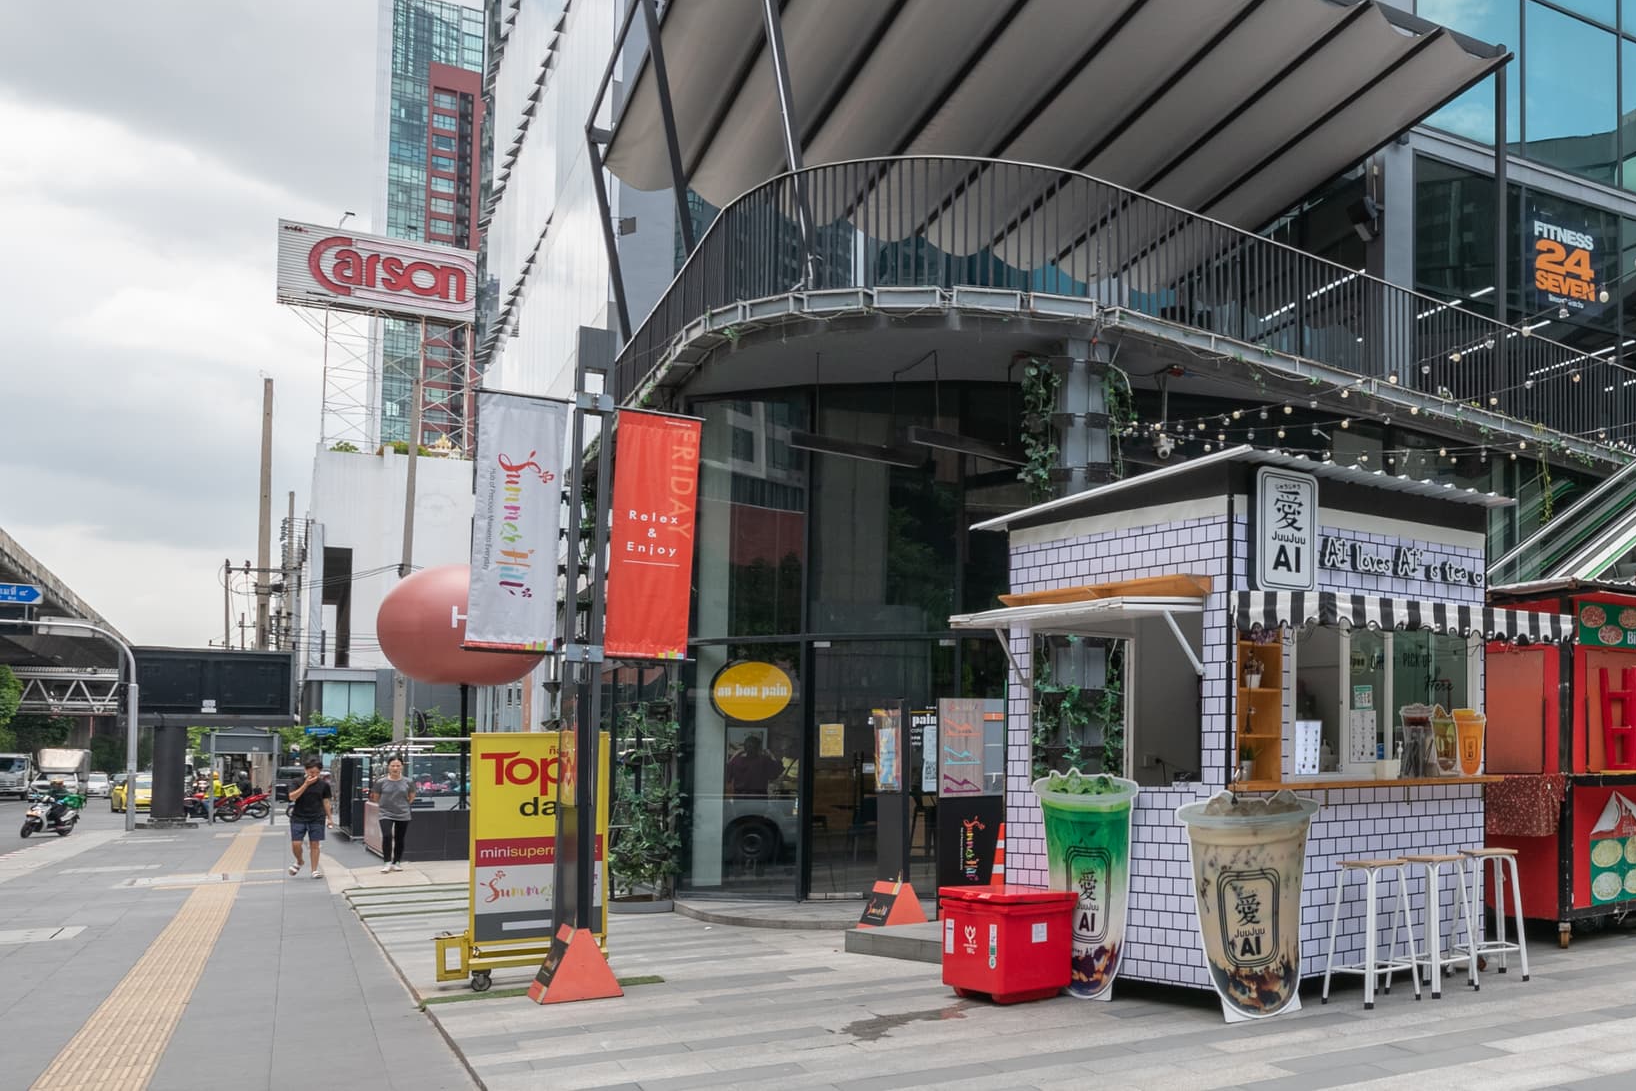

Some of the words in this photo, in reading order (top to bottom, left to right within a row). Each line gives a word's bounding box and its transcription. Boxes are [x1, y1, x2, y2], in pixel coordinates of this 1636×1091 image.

[1533, 220, 1594, 251] FITNESS
[308, 236, 467, 302] Carson
[1535, 239, 1595, 282] 24
[1535, 270, 1596, 302] SEVEN
[667, 428, 697, 540] FRIDAY
[1274, 490, 1304, 532] 愛
[648, 528, 657, 538] &
[1272, 531, 1306, 545] JuuJuu
[626, 541, 678, 558] Enjoy
[1272, 544, 1301, 573] AI
[1357, 541, 1391, 573] loves
[1448, 561, 1467, 582] tea
[717, 685, 732, 697] au
[735, 683, 758, 697] bon
[762, 683, 788, 700] pain
[481, 751, 560, 796] Top
[1079, 913, 1095, 932] AI
[1235, 893, 1261, 927] 愛
[1234, 927, 1266, 938] JuuJuu
[1241, 936, 1262, 957] AI
